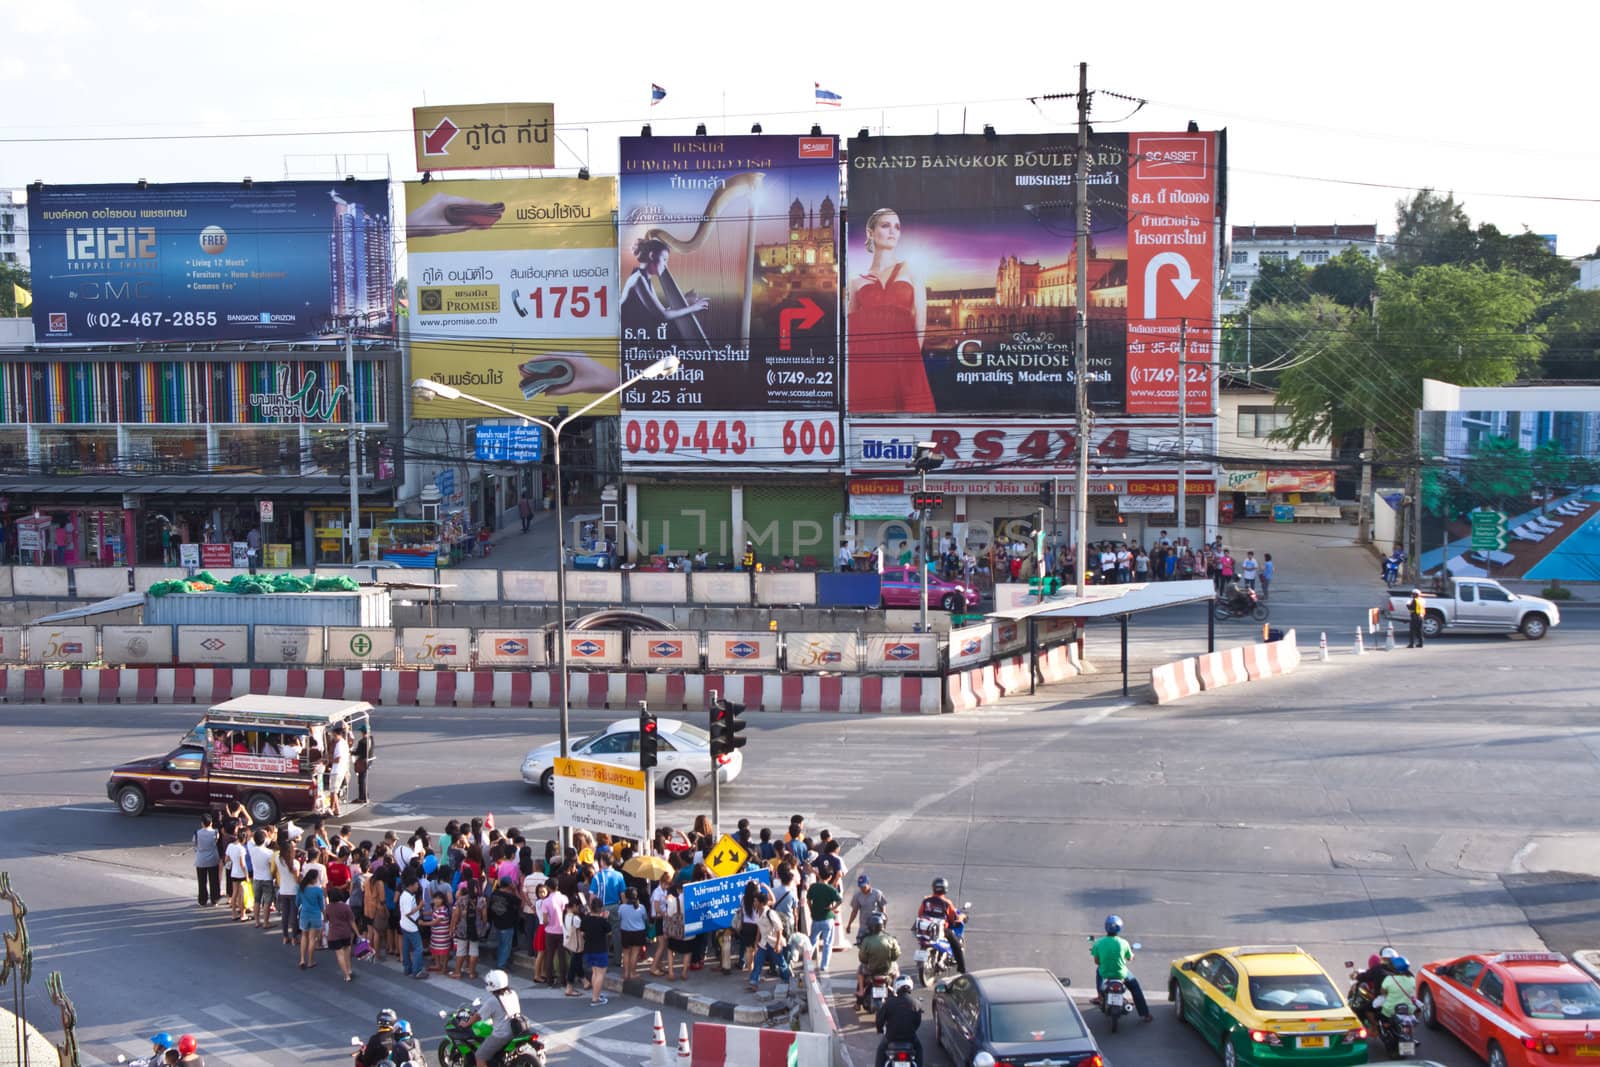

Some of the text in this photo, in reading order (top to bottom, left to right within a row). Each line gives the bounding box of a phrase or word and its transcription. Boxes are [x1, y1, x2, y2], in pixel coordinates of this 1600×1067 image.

[465, 119, 548, 149] กู้ได้ ที่นี่
[855, 153, 1121, 168] GRAND BANGKOK BOULEARD
[1145, 152, 1198, 161] SC ASSET
[1015, 175, 1071, 186] เพชรเกษม
[516, 203, 590, 220] พร้อมใช้เงิน
[66, 227, 157, 260] 121212
[203, 235, 225, 245] FREE
[422, 266, 493, 284] กู้ได้ อนุมัติไว
[510, 267, 568, 280] สินเชื่อบุคคล
[447, 300, 498, 311] PROMISE
[529, 285, 608, 319] 1751
[99, 312, 218, 327] 02-467-2855
[227, 314, 259, 322] BANGKOK
[420, 317, 498, 327] www.promise.co.th
[657, 323, 668, 340] นี้
[957, 340, 1069, 366] GRANDIOSE
[1000, 344, 1069, 352] PASSION FOR
[828, 355, 834, 364] 2
[777, 372, 804, 384] 1749
[816, 372, 833, 384] 22
[1018, 371, 1062, 382] Modern
[1143, 368, 1174, 382] 1749
[626, 388, 702, 403] เริ่ม 25 ล้าน
[768, 389, 833, 397] www.scasset.com
[783, 420, 835, 455] 600
[863, 438, 913, 460] ฟิล์ม
